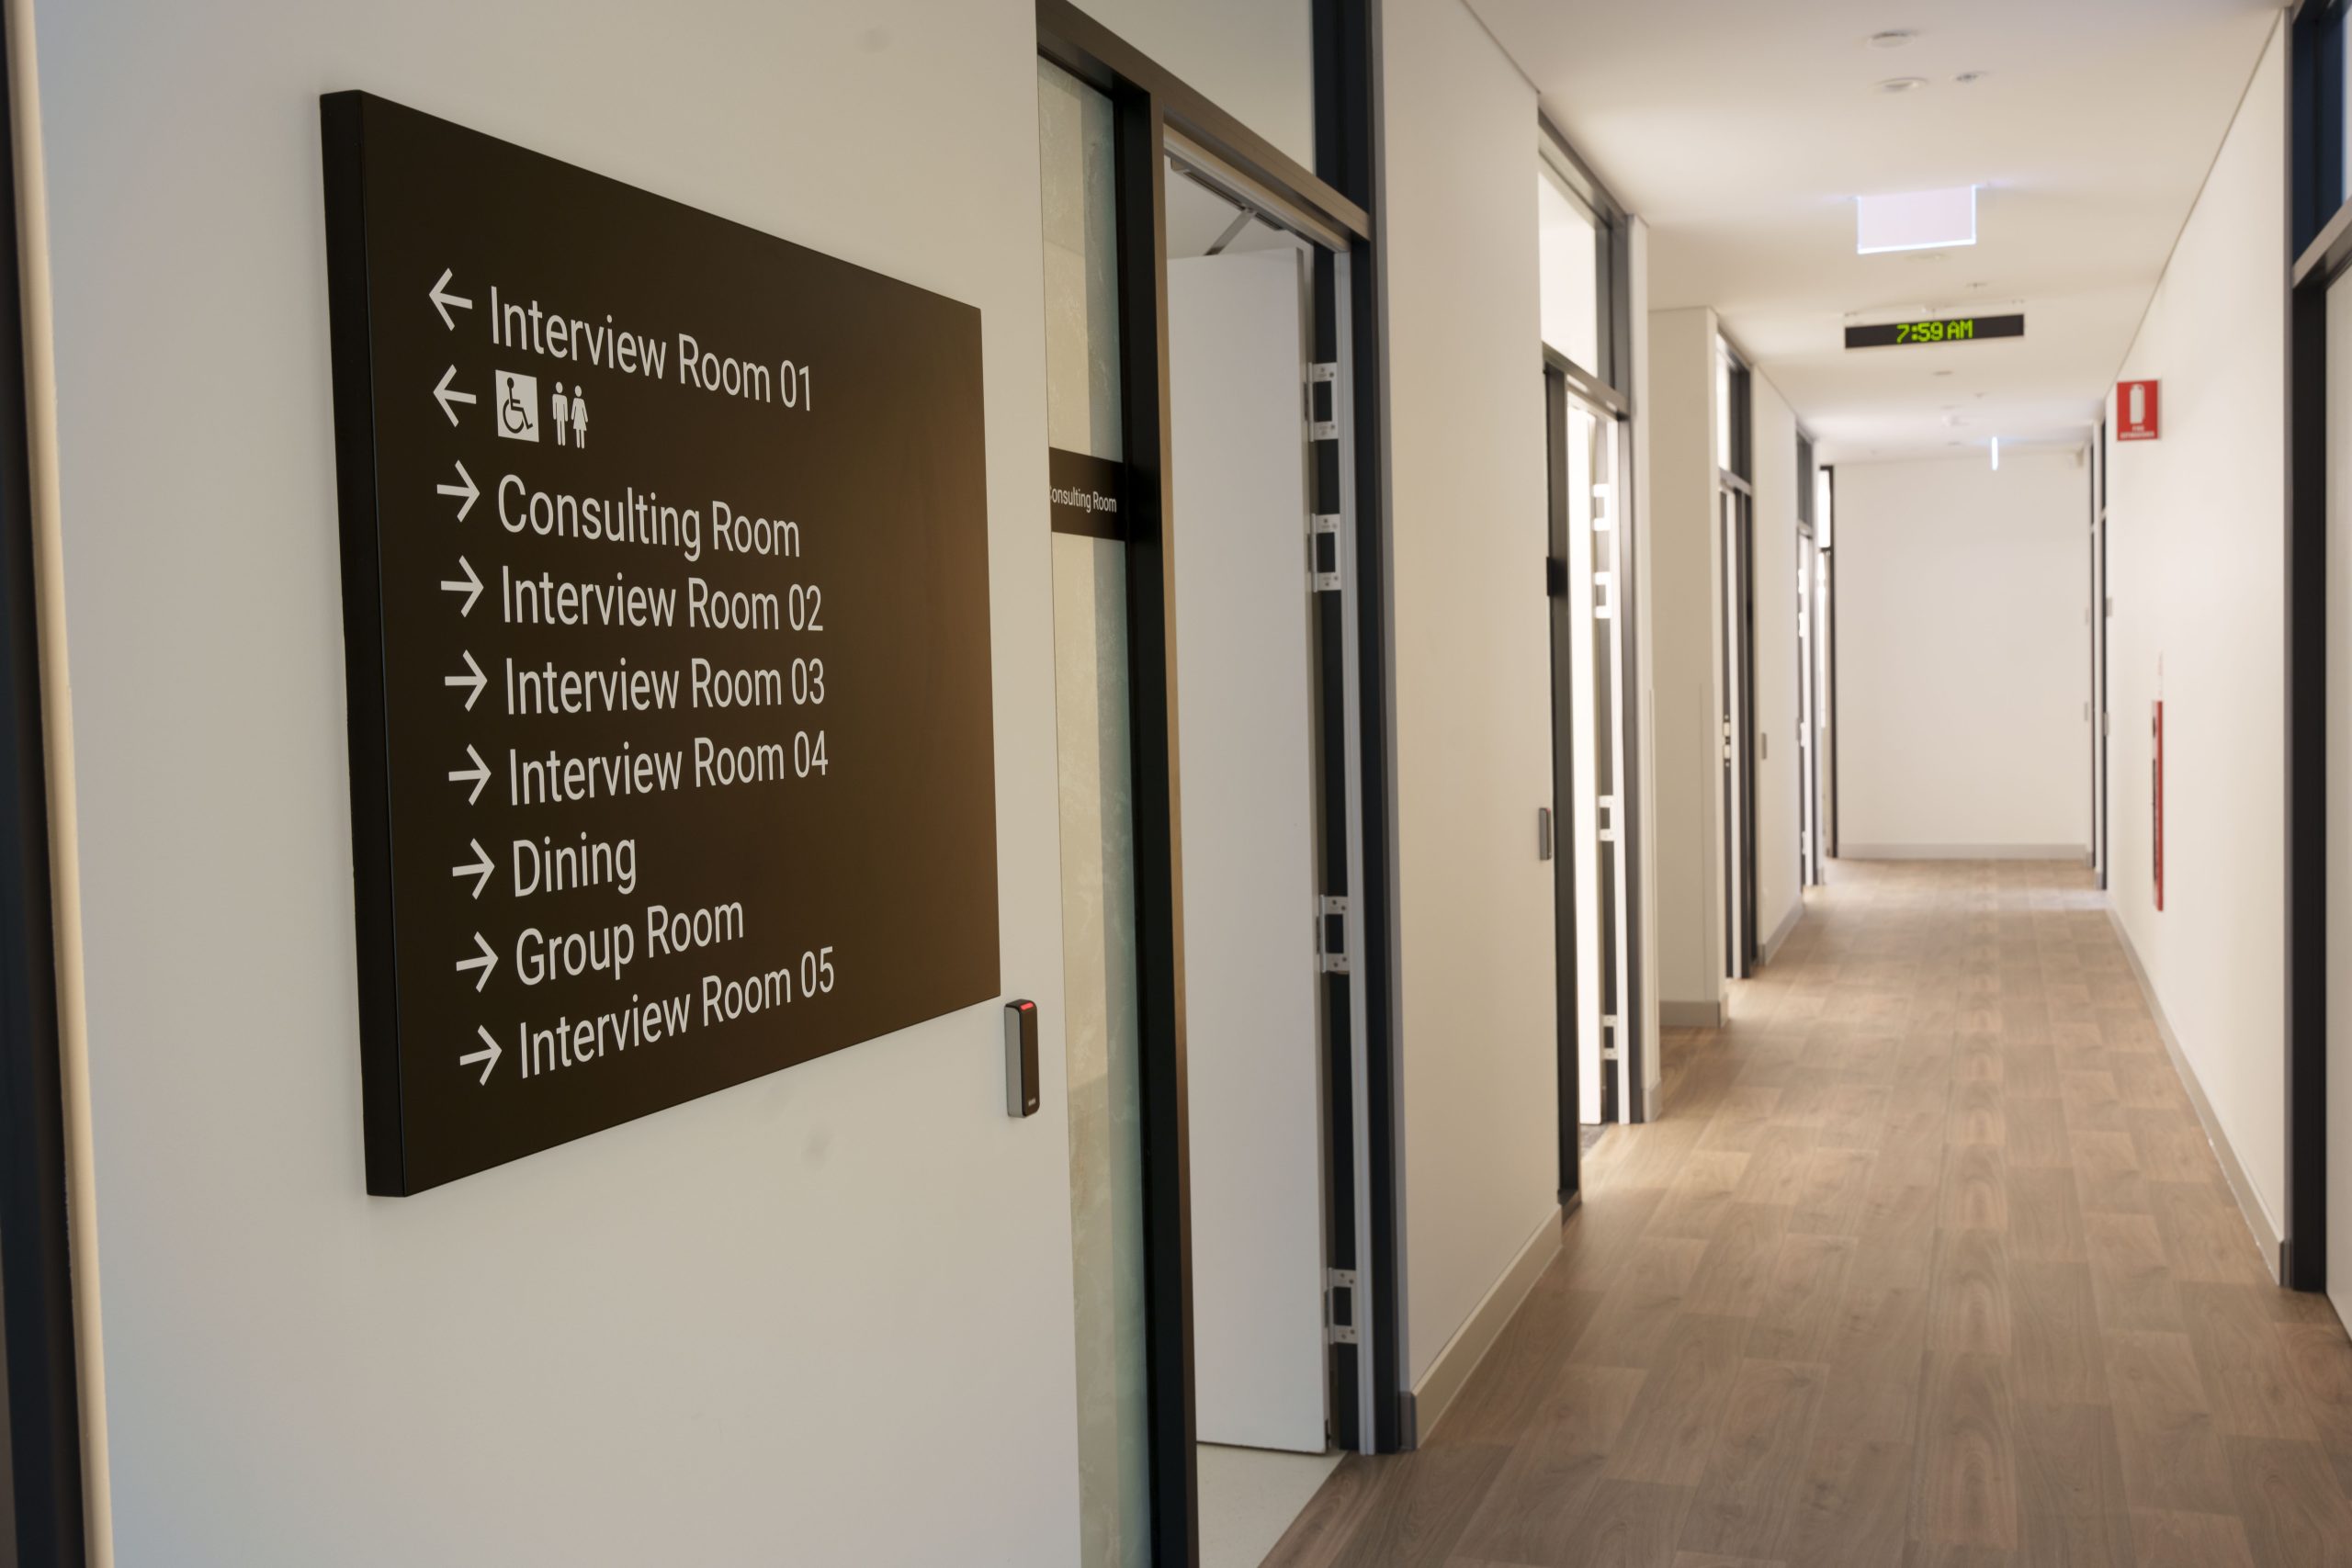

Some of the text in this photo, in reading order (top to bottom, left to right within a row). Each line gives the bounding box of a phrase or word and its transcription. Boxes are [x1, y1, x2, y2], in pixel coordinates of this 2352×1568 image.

[491, 286, 811, 412] Interview Room 01
[1896, 319, 1973, 344] 7:59 AM
[498, 474, 800, 562] Consulting Room
[1049, 485, 1117, 513] onsulting Room
[502, 565, 824, 632] Interview Room 02
[506, 657, 825, 715] Interview Room 03
[509, 729, 829, 807] Interview Room 04
[513, 831, 637, 897] Dining
[515, 901, 744, 986] Group Room
[520, 945, 834, 1079] Interview Room 05
